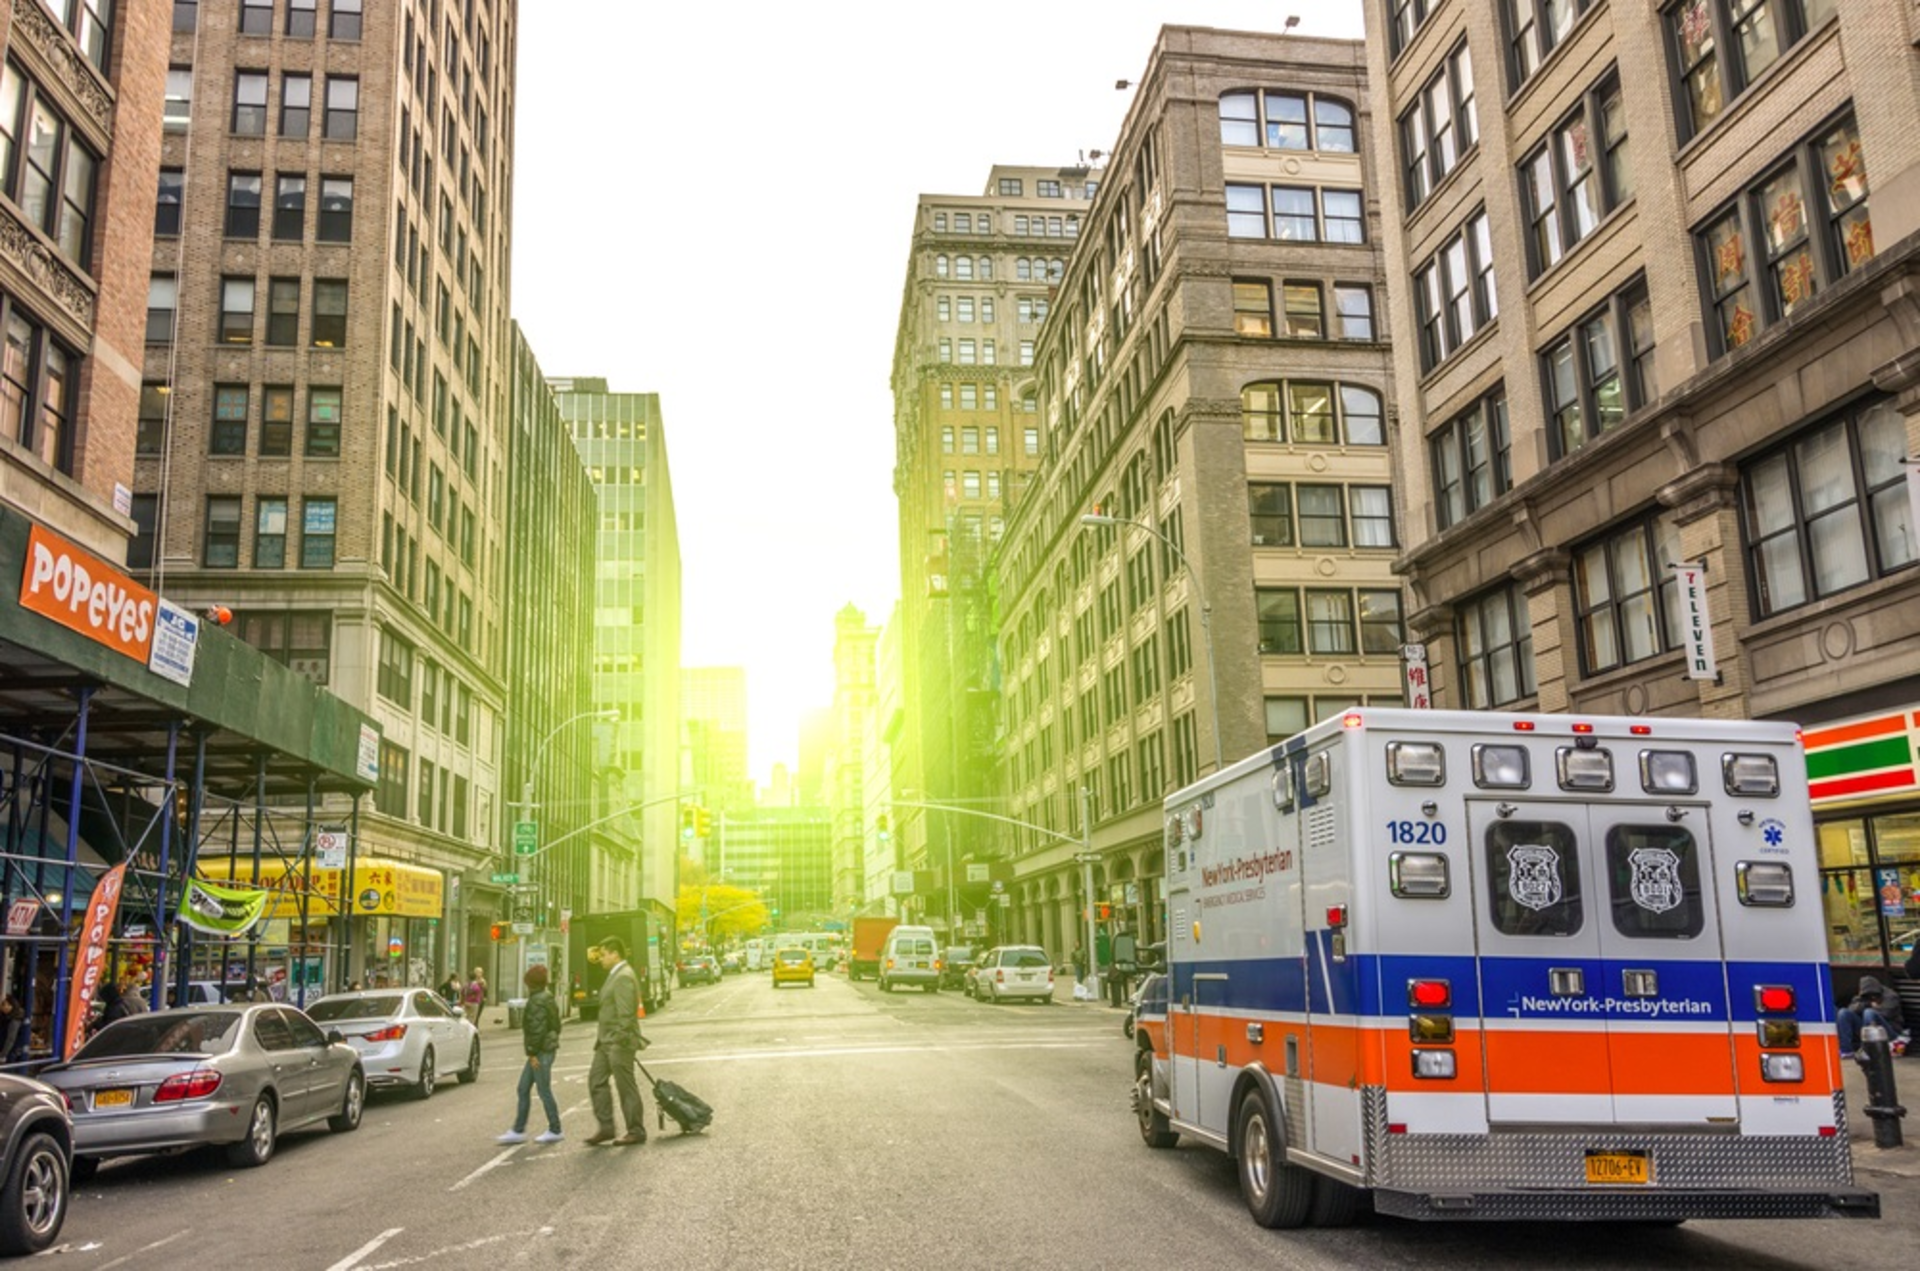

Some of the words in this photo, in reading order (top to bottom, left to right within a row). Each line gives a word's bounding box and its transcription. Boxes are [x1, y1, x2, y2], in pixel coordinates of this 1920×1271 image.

[1387, 821, 1447, 845] 1820
[10, 905, 36, 926] ATM
[1522, 996, 1712, 1017] NewYork-Presbyterian
